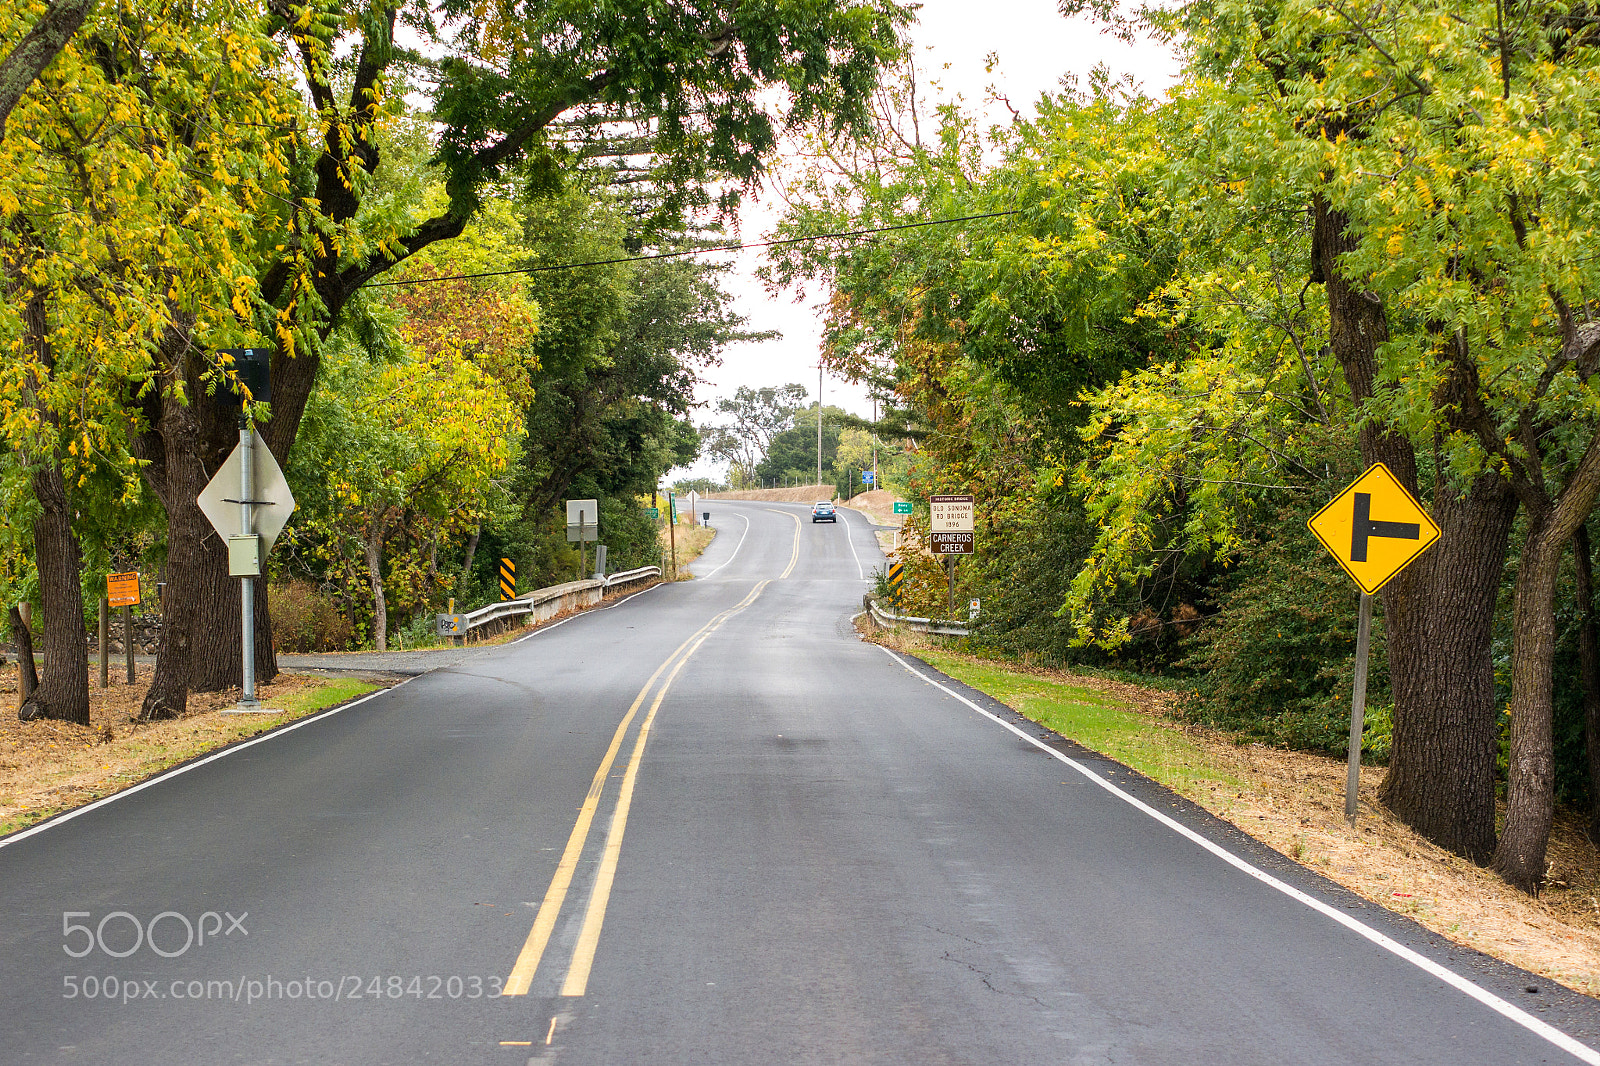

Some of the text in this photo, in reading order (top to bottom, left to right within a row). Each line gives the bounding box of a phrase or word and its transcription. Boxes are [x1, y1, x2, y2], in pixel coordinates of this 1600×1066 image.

[933, 534, 971, 542] CARNEROS
[940, 544, 964, 552] CREEK
[109, 574, 136, 582] WARNING
